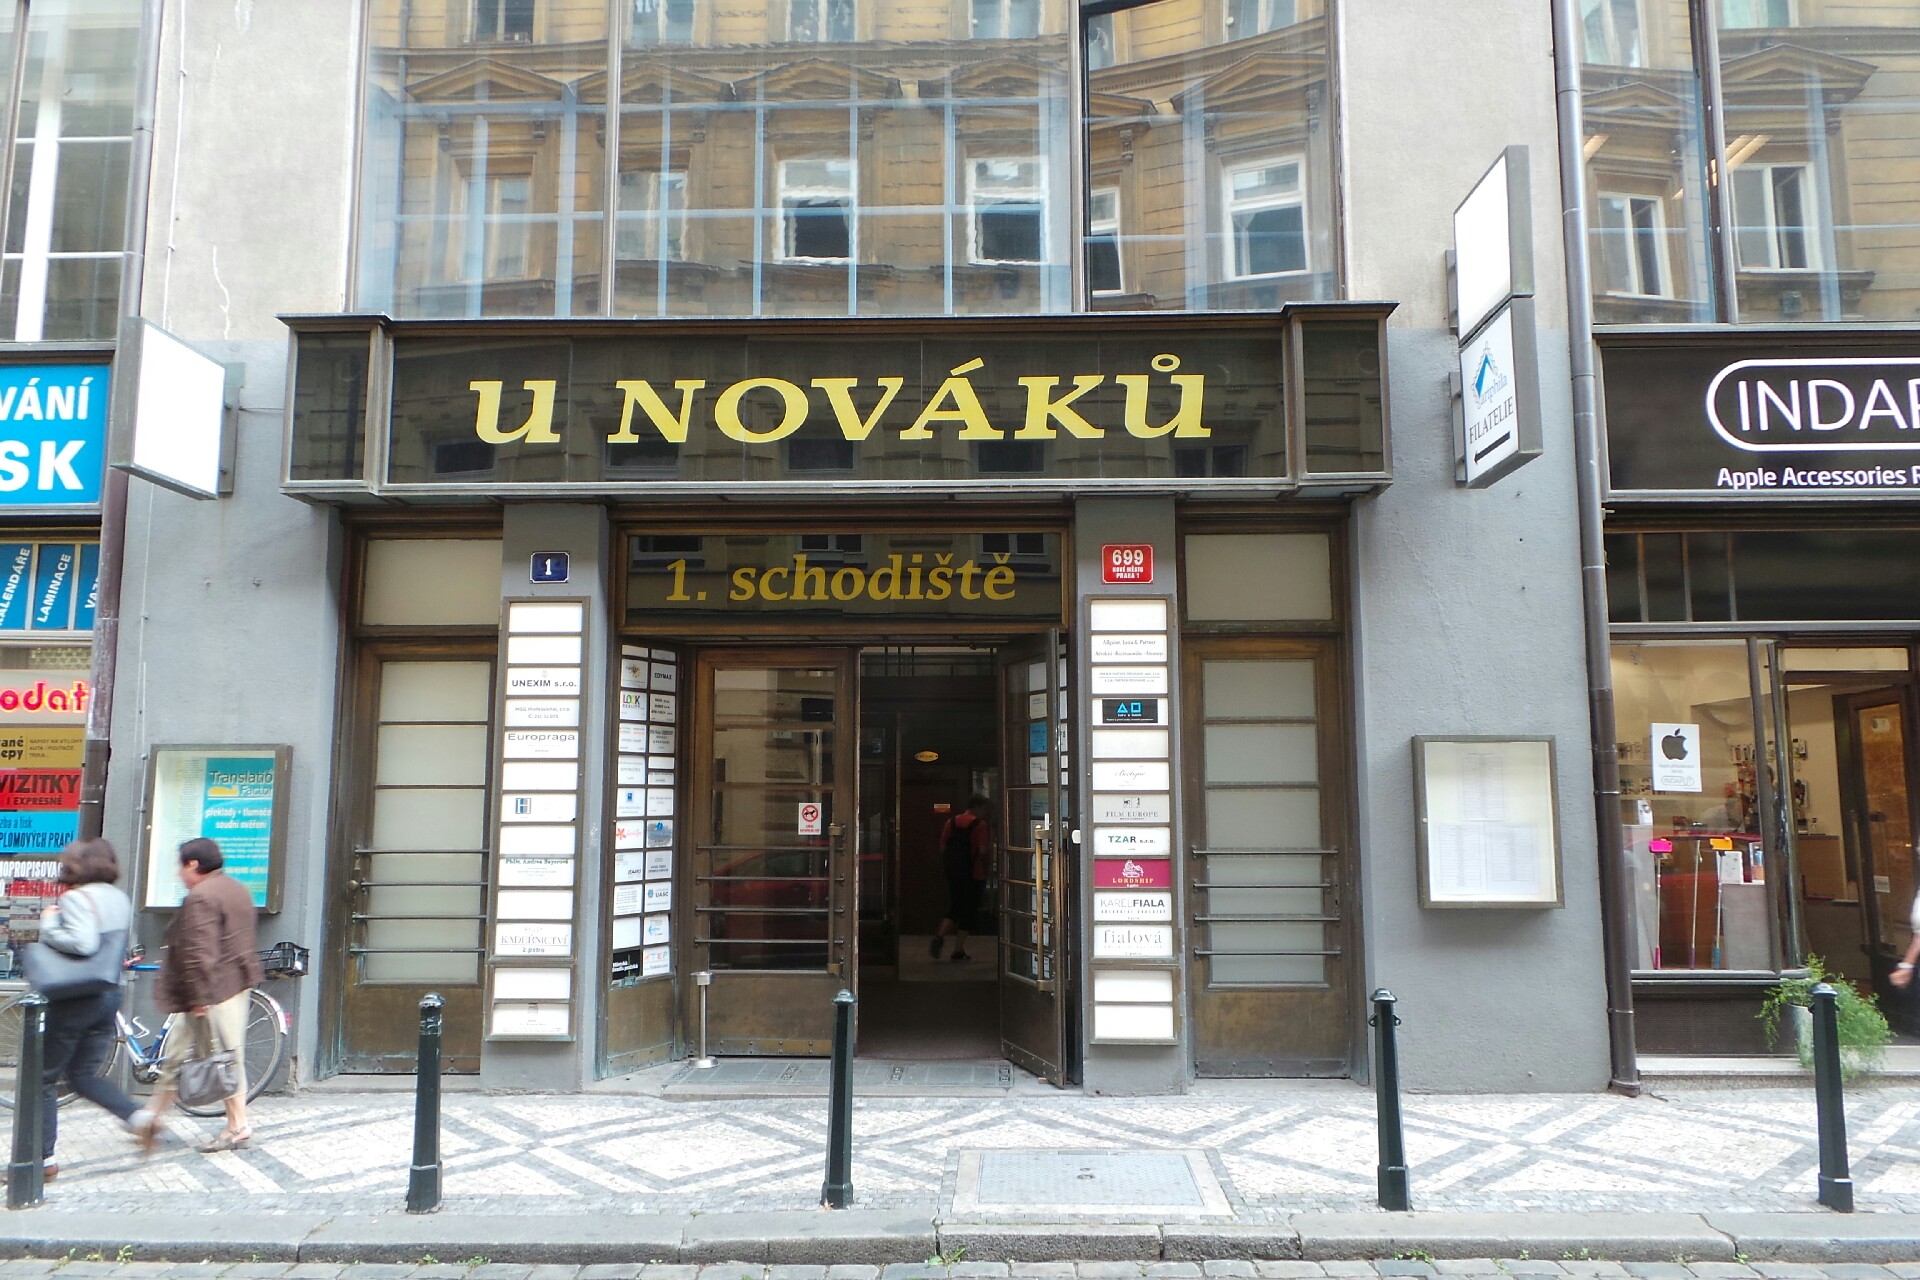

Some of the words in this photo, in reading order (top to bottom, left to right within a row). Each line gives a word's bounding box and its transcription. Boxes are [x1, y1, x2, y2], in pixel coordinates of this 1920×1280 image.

[469, 379, 561, 444] u
[1469, 396, 1515, 445] FILATELIE
[1717, 467, 1777, 489] Apple
[1782, 466, 1907, 486] Accessories
[1112, 549, 1144, 565] 699
[545, 558, 552, 576] 1
[665, 558, 707, 601] 1.
[729, 553, 1016, 600] schodiště
[36, 553, 72, 623] LAMINACE
[511, 679, 551, 687] UNEXIM
[0, 736, 24, 747] ané
[507, 733, 576, 742] Europraga
[1107, 835, 1137, 844] TZAR
[1104, 929, 1162, 944] fialová
